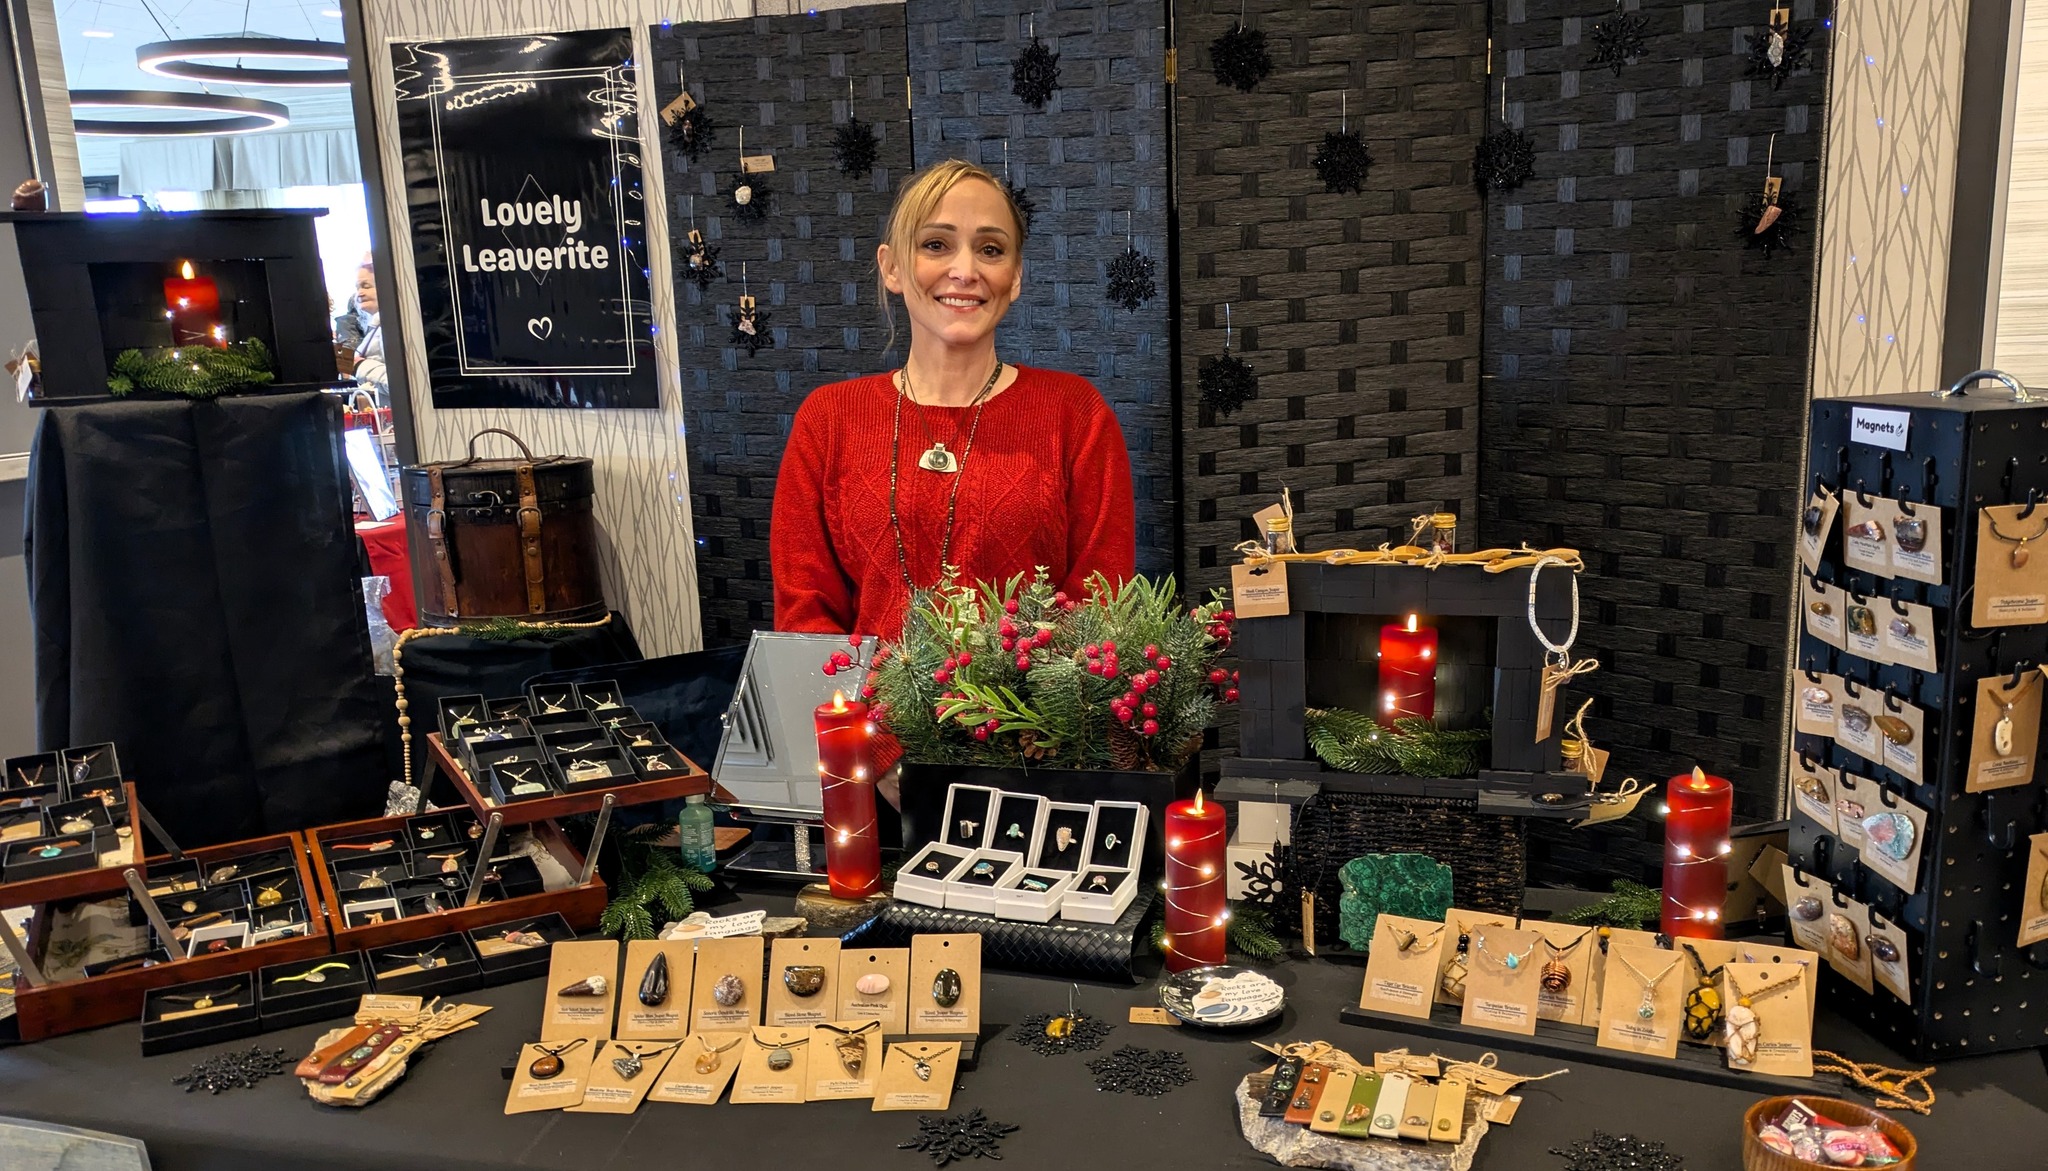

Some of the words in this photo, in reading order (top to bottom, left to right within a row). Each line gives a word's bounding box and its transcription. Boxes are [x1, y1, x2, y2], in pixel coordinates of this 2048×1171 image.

[481, 194, 581, 233] Lovely
[462, 237, 609, 272] Leaverite
[1856, 417, 1895, 434] Magnets
[705, 917, 738, 925] Rocks
[732, 919, 756, 927] love
[704, 925, 758, 936] language
